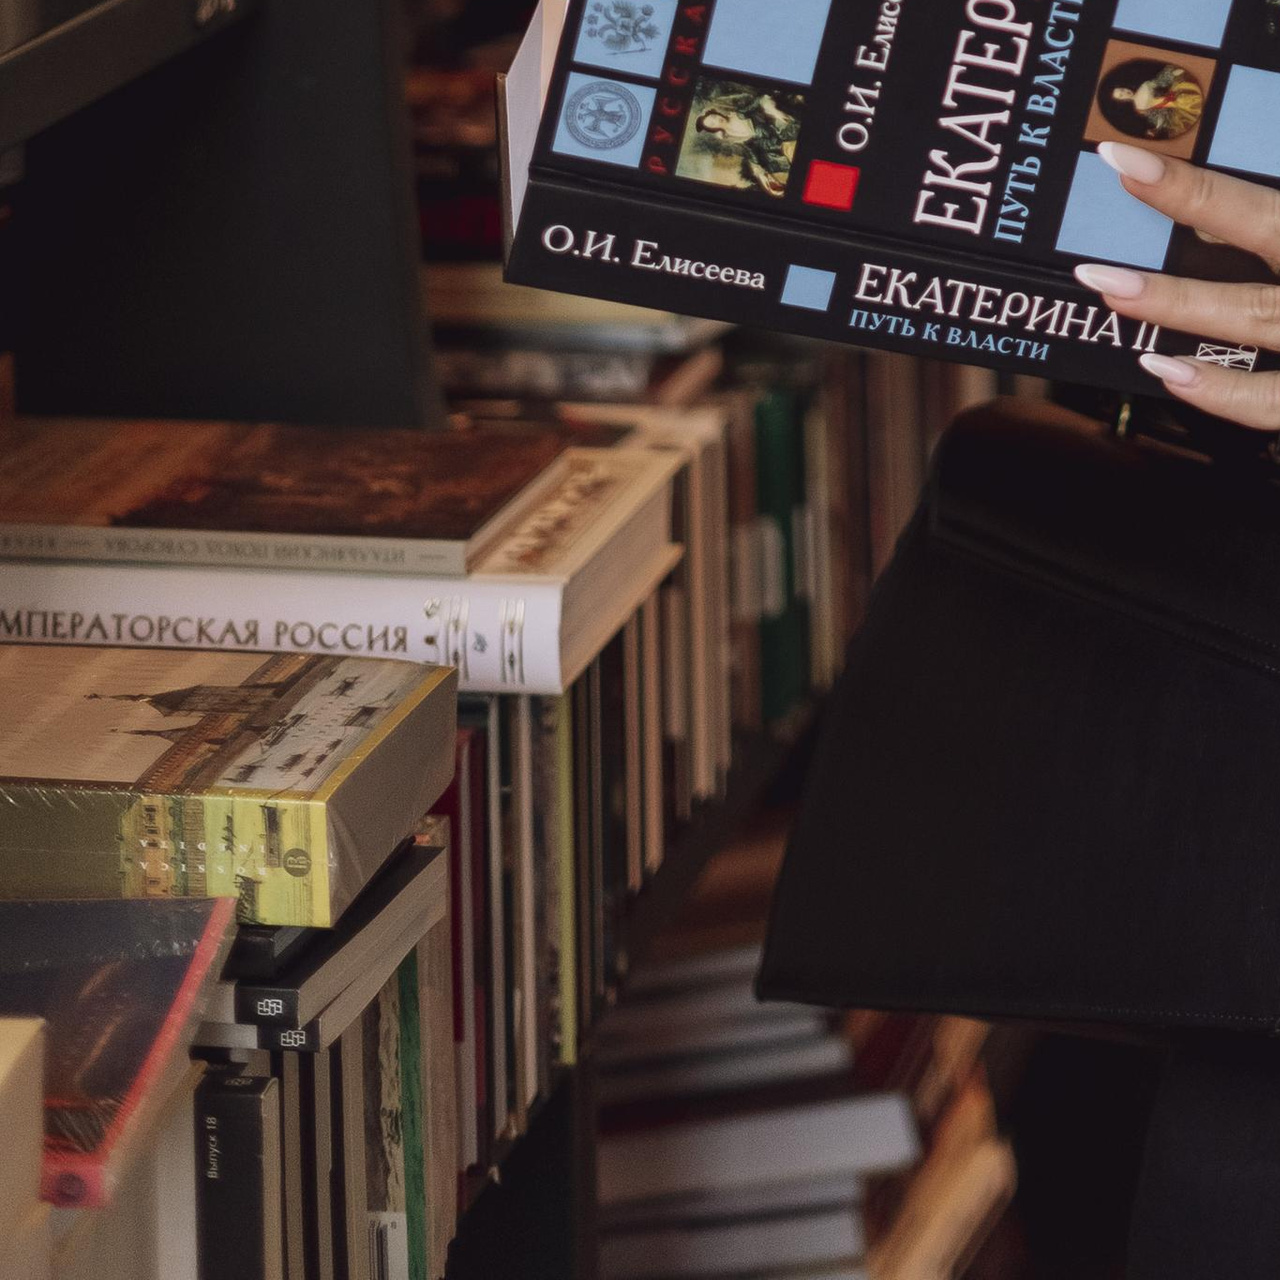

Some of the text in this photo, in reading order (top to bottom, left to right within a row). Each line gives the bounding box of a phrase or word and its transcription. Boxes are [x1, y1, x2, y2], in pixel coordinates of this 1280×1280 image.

[836, 80, 882, 152] О.И.
[993, 154, 1042, 244] ПУТЬ
[1018, 122, 1051, 147] К
[541, 224, 766, 290] О.И. Елисеева
[848, 308, 1050, 361] ПУТЬ К ВЛАСТИ
[853, 262, 1160, 353] ЕКАТЕРИНА II
[0, 609, 409, 653] МПЕРАТОРСКАЯ РОССИЯ
[139, 839, 266, 854] INEDITA
[140, 861, 267, 876] ROSSICA
[207, 1115, 221, 1180] Выпуск 18
